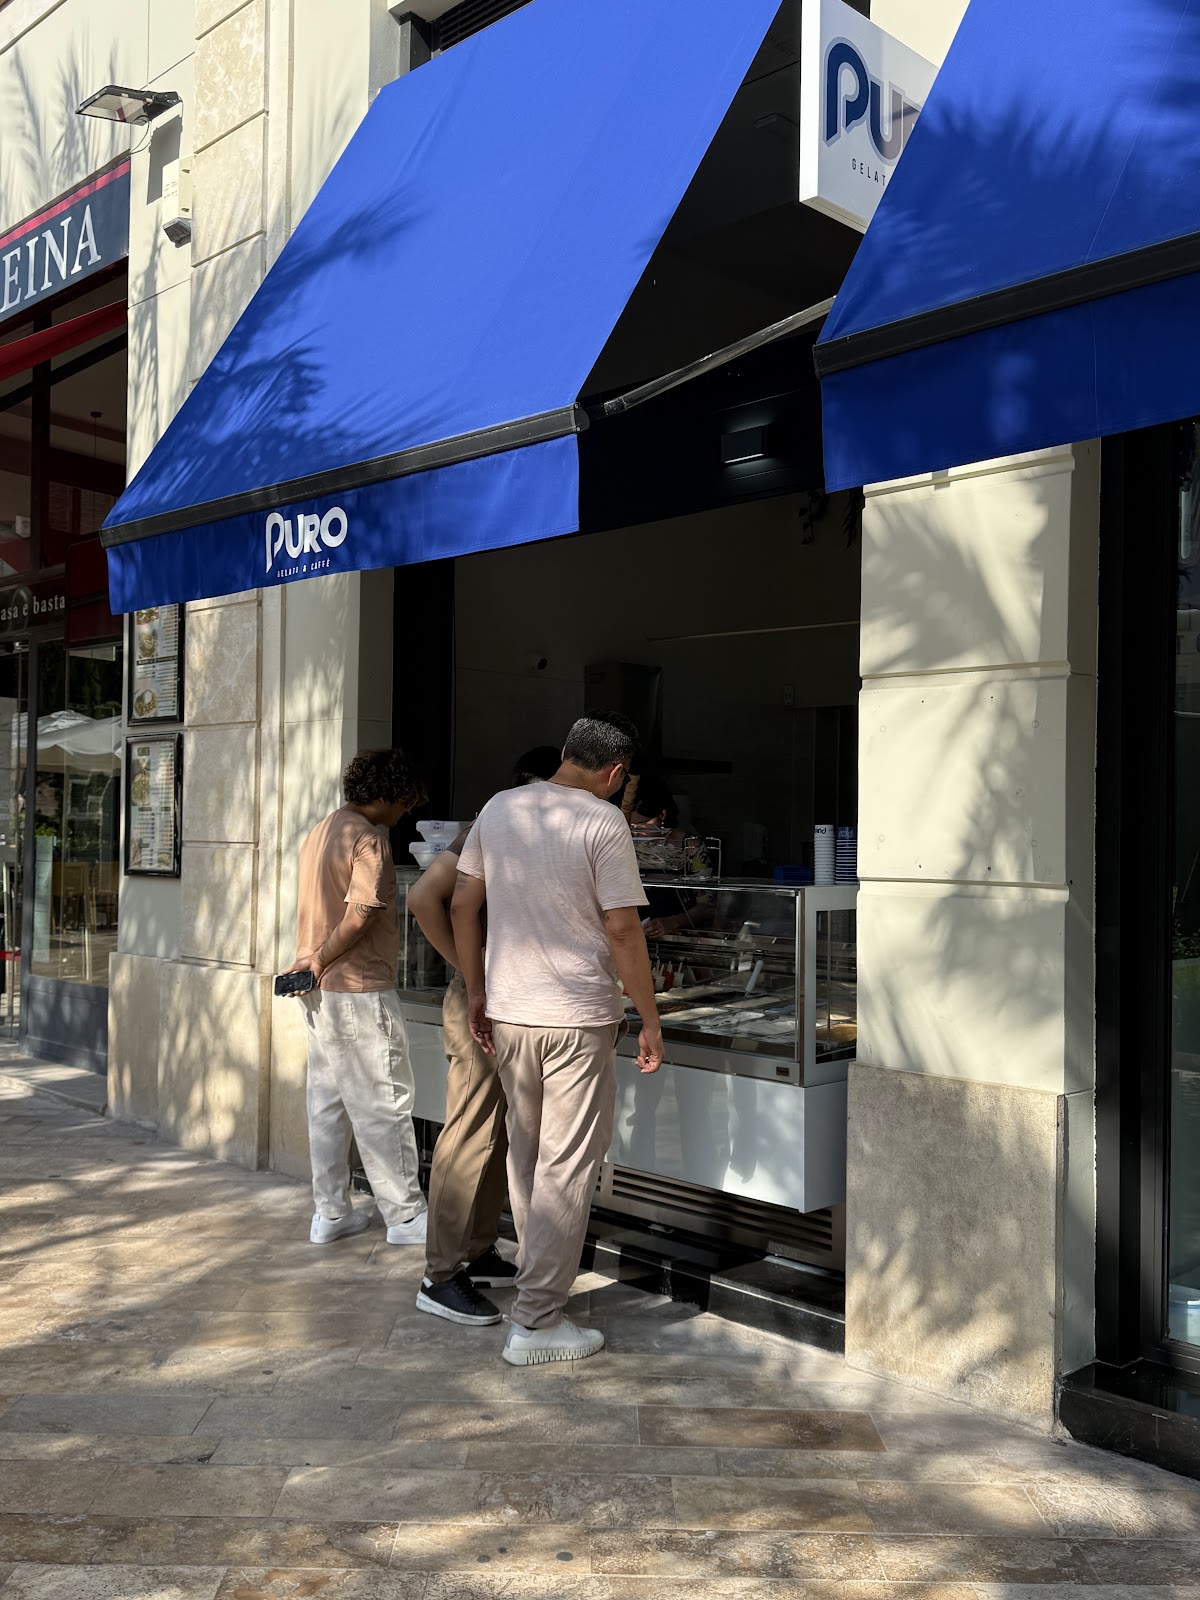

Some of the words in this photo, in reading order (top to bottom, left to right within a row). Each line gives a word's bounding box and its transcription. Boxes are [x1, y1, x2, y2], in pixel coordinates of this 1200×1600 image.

[266, 506, 348, 574] PURO
[22, 603, 29, 616] e
[32, 594, 66, 615] basta
